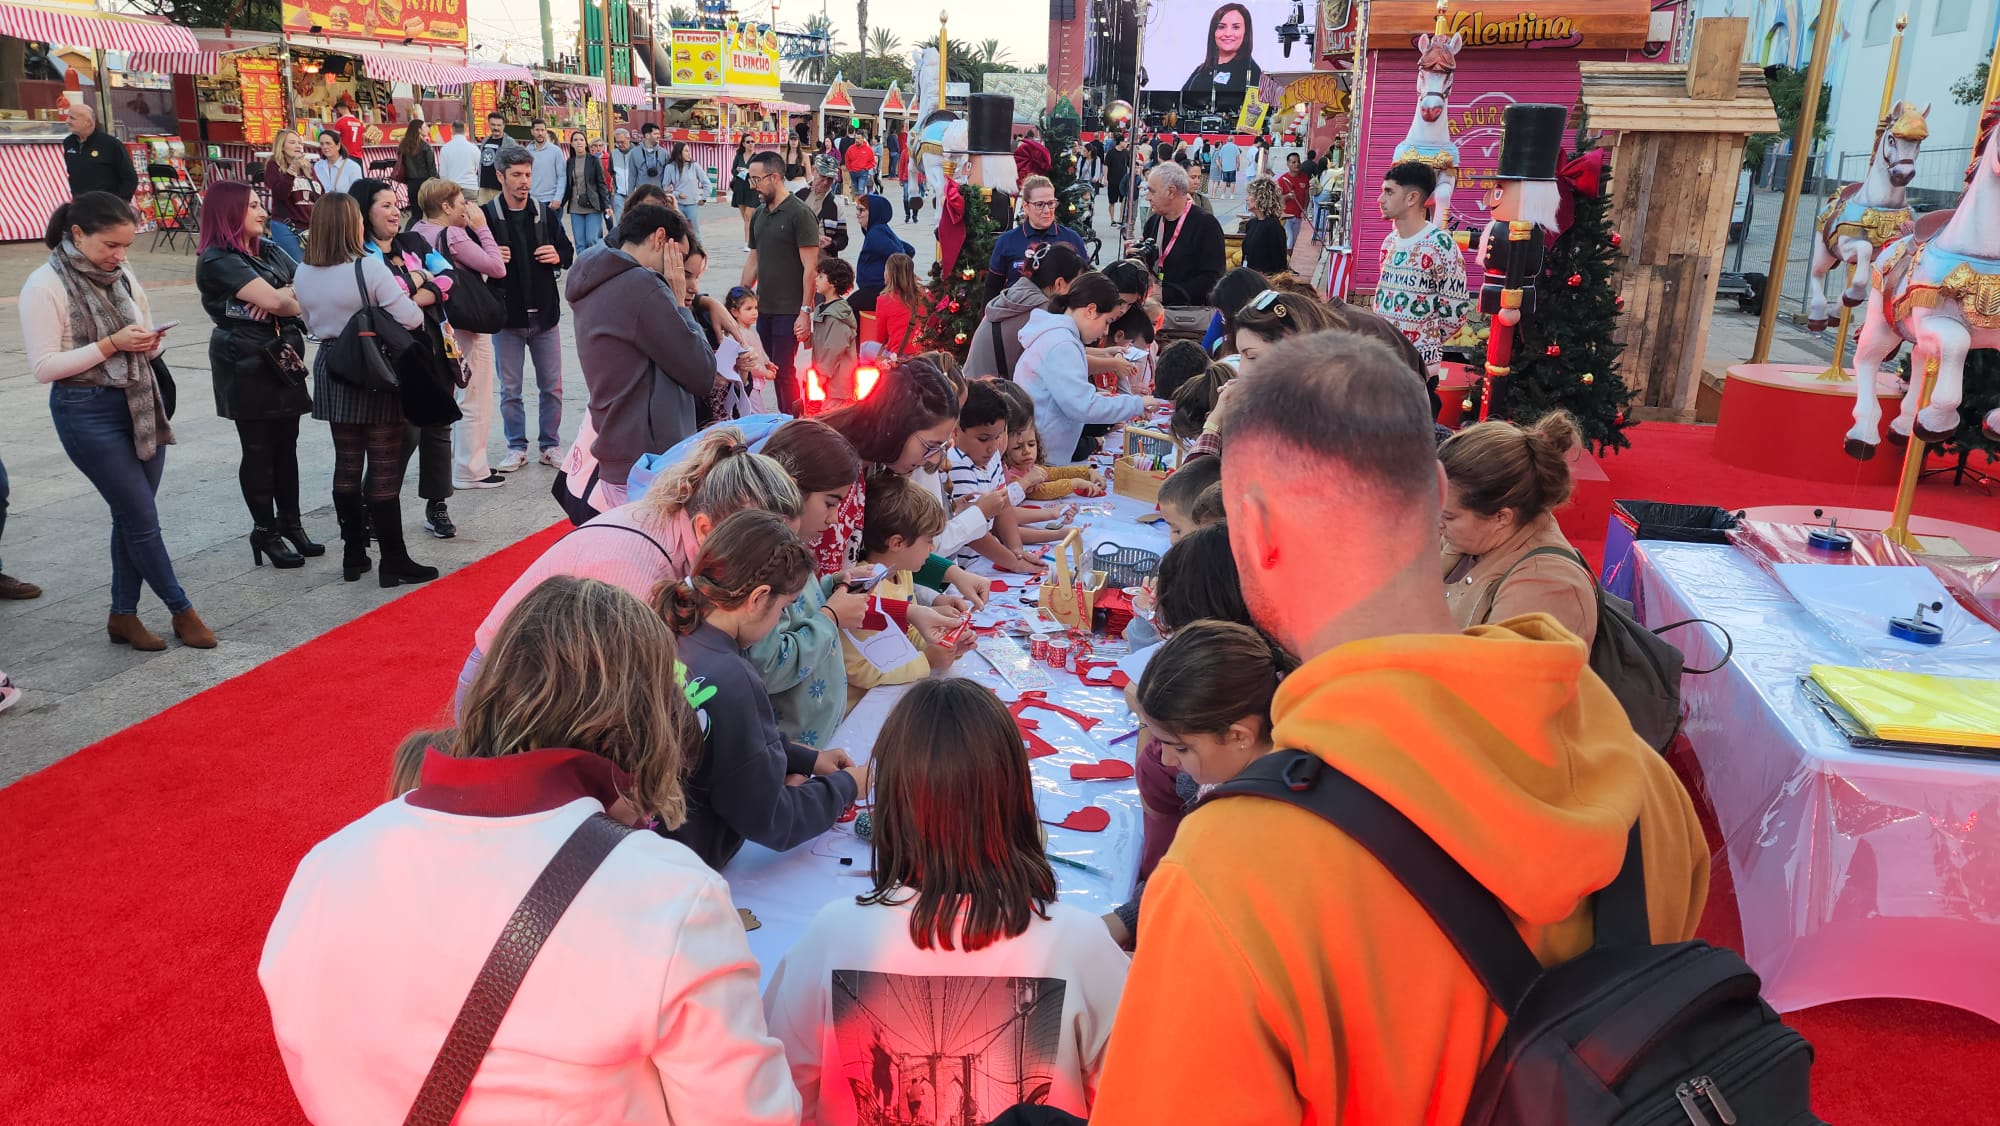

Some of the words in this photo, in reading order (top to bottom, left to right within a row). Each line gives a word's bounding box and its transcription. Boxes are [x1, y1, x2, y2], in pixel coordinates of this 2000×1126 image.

[1443, 10, 1572, 47] Valentina
[687, 35, 718, 43] PINCHO
[733, 54, 742, 67] EL
[743, 55, 770, 72] PINCHO
[1449, 277, 1467, 294] XM
